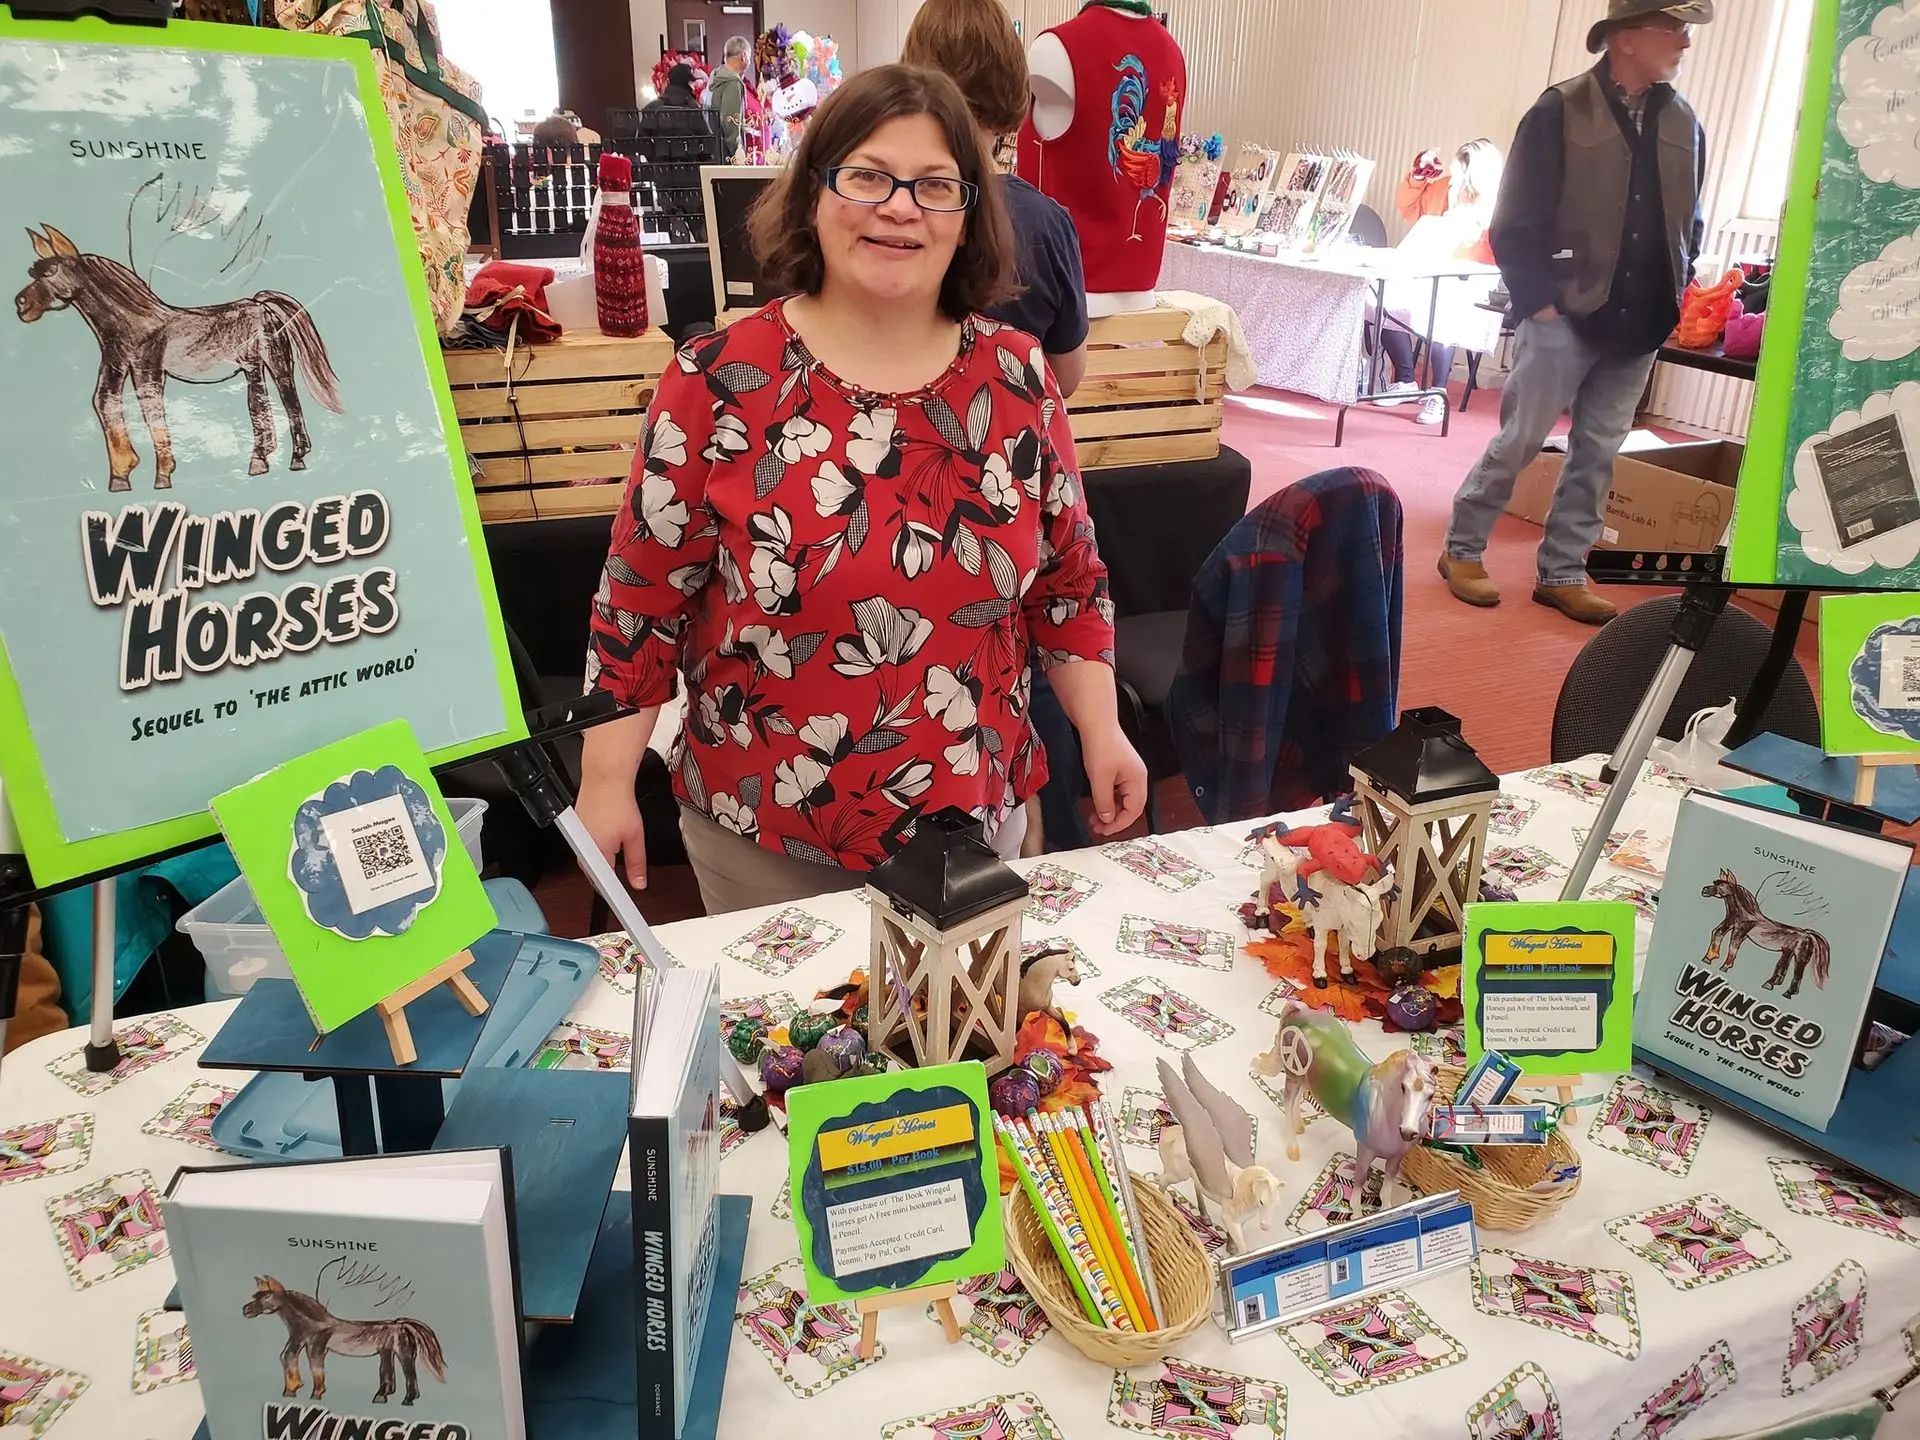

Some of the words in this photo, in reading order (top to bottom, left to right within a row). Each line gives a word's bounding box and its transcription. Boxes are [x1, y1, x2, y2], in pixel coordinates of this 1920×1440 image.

[69, 139, 206, 160] SUNSHINE
[1605, 504, 1630, 520] Bambu
[1631, 513, 1645, 525] Lab
[1646, 518, 1656, 528] A1
[82, 489, 391, 604] WINGED
[120, 567, 400, 690] HORSES
[131, 708, 204, 741] SEQUEL
[213, 699, 237, 719] TO
[299, 671, 348, 698] ATTIC
[351, 824, 373, 834] Sarah
[373, 817, 396, 827] Magee
[1753, 847, 1817, 874] SUNSHINE
[1559, 964, 1582, 973] Book
[1675, 961, 1825, 1048] WINGED
[1669, 997, 1812, 1078] HORSES
[1663, 1031, 1695, 1050] SEQUEL
[1698, 1047, 1710, 1057] TO
[1736, 1065, 1764, 1082] ATTIC
[847, 1124, 895, 1149] Winged
[896, 1117, 937, 1135] Horses
[645, 1148, 657, 1202] SUNSHINE
[846, 1159, 883, 1176] $15.00
[891, 1153, 910, 1166] Per
[912, 1148, 941, 1161] Book
[829, 1206, 848, 1217] With
[848, 1201, 878, 1215] purchase
[879, 1198, 888, 1206] of
[890, 1195, 904, 1206] The
[905, 1191, 924, 1202] Book
[924, 1184, 951, 1199] Winged
[831, 1218, 856, 1229] Horses
[857, 1215, 868, 1225] get
[868, 1213, 876, 1221] A
[876, 1210, 891, 1219] Free
[892, 1206, 908, 1216] mini
[909, 1199, 943, 1213] bookmark
[944, 1194, 957, 1205] and
[288, 1237, 378, 1252] SUNSHINE
[834, 1243, 869, 1256] Payments
[904, 1230, 926, 1240] Credit
[864, 1251, 877, 1262] Pay
[893, 1244, 911, 1254] Cash
[643, 1230, 665, 1295] WINGED
[646, 1296, 667, 1352] HORSES
